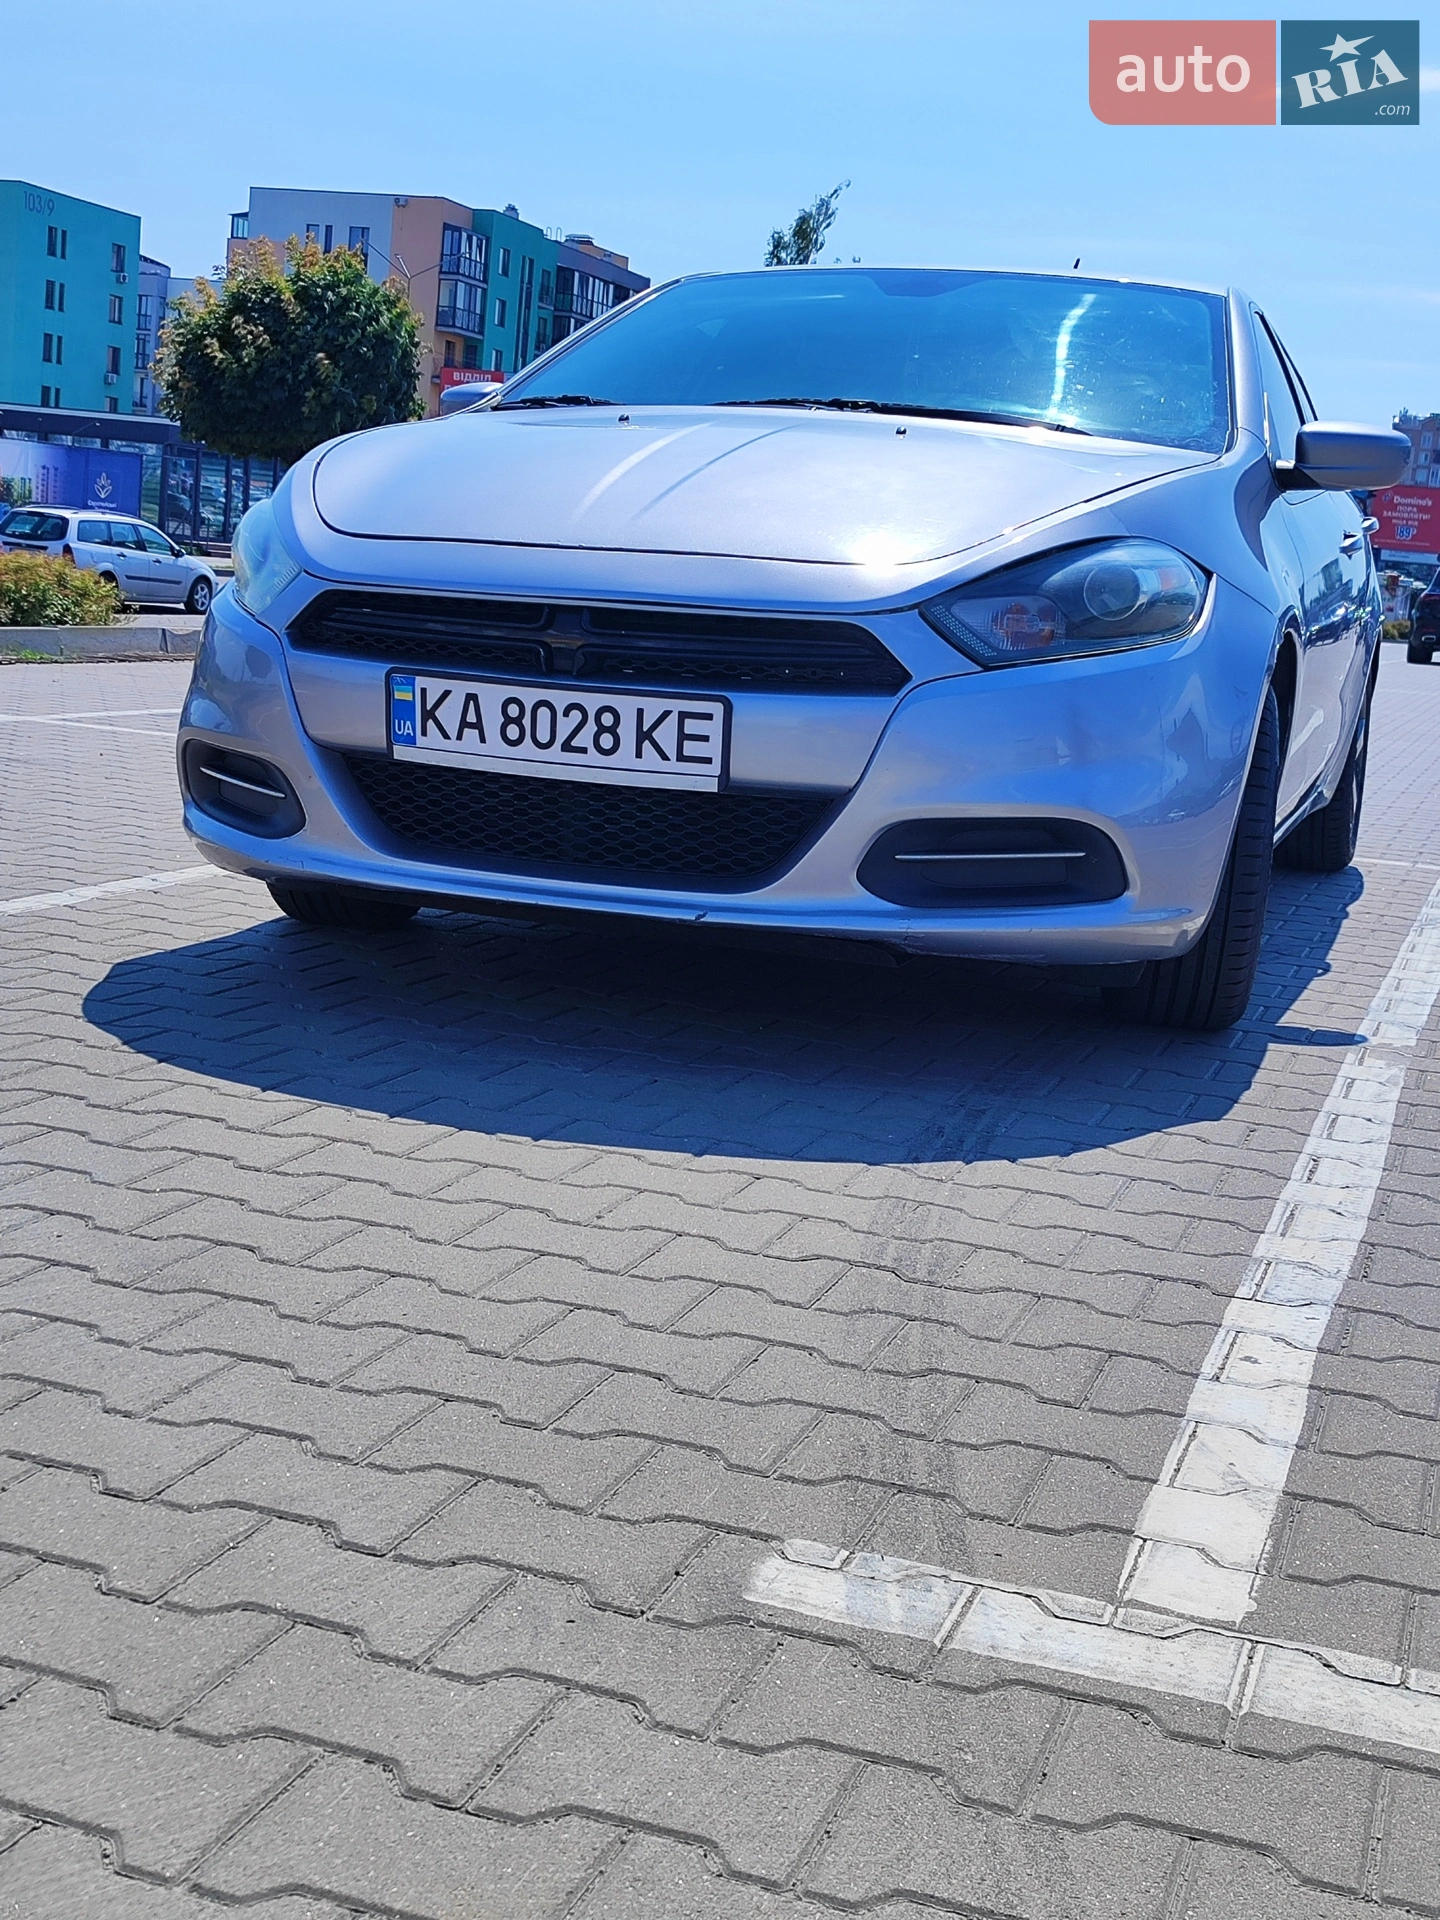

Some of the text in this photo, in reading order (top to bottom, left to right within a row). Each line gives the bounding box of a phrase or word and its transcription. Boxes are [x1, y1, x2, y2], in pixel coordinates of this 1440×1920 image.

[23, 190, 55, 217] 103/9
[1394, 496, 1432, 506] Domino's
[394, 686, 715, 765] UA KA 8028 KE
